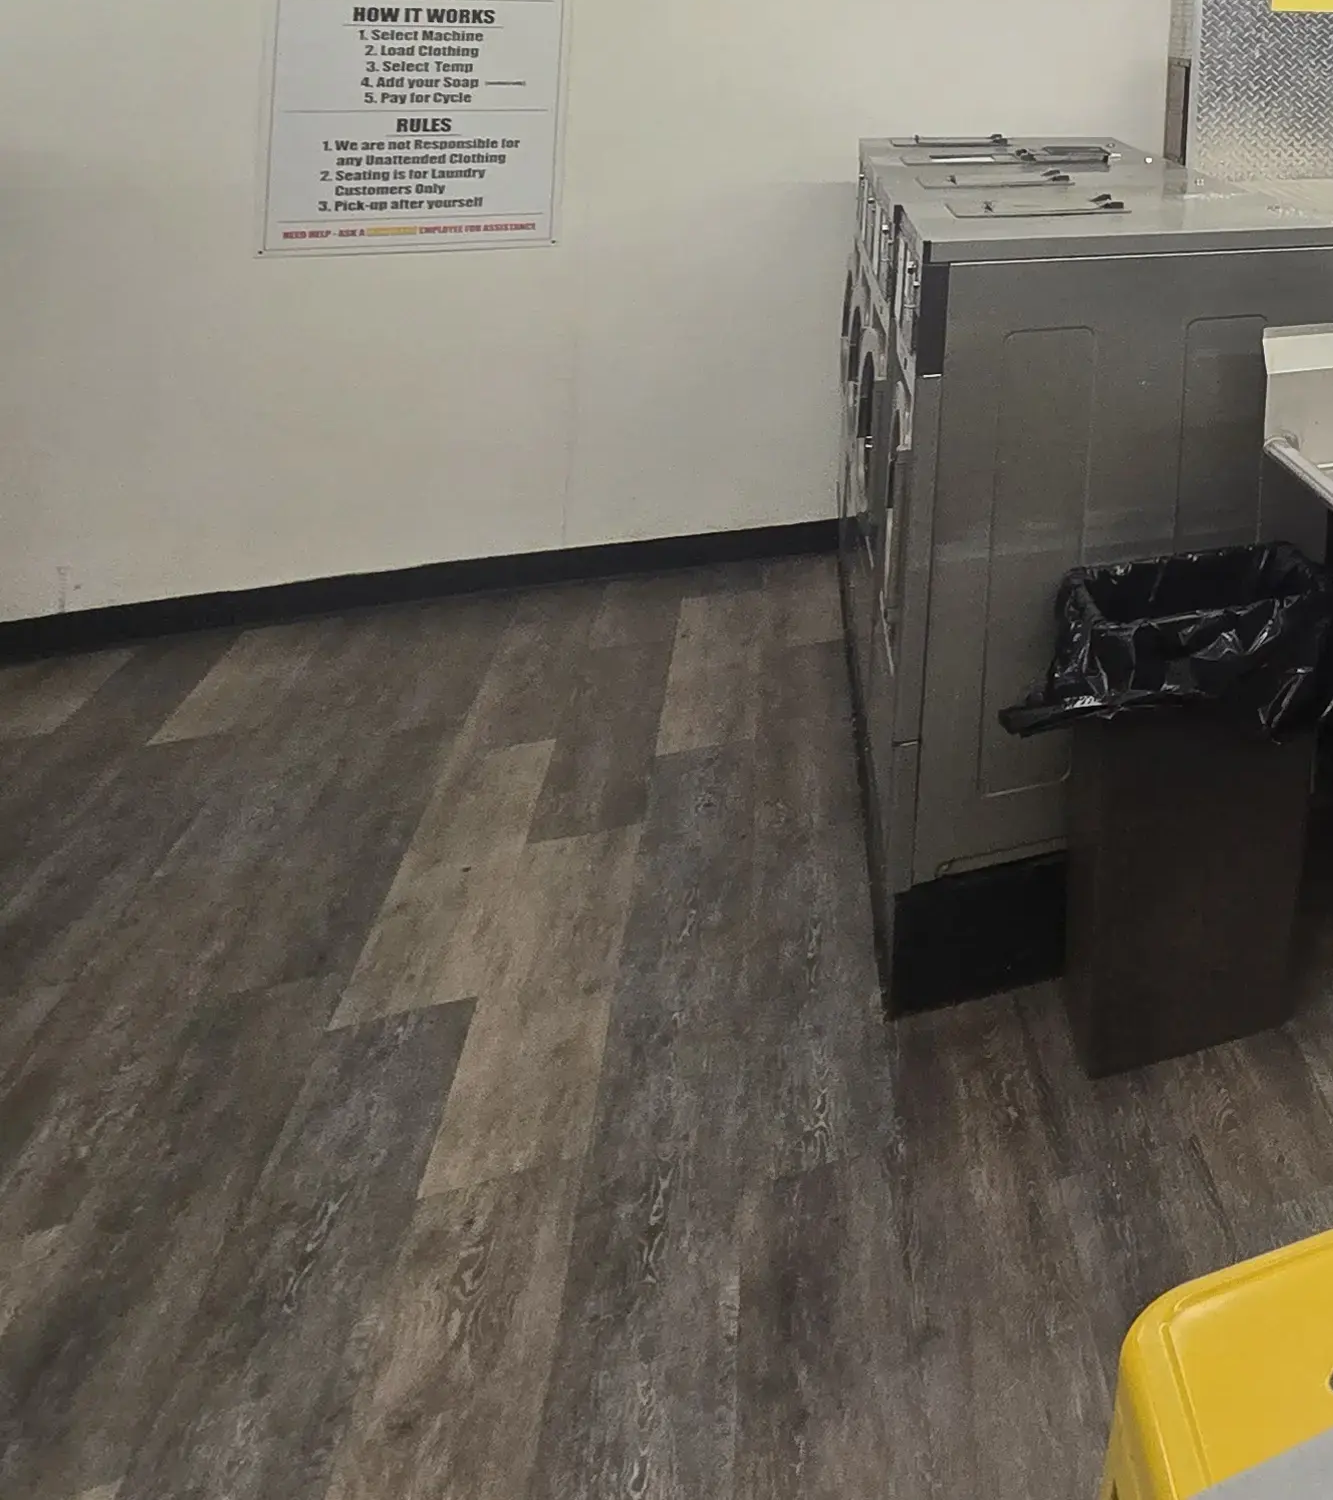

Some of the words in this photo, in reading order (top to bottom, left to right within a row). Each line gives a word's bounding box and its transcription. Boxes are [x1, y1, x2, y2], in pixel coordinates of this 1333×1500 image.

[353, 7, 400, 23] HOW
[404, 8, 423, 23] IT
[426, 8, 496, 24] WORKS
[358, 29, 369, 41] 1.
[371, 29, 419, 41] Select
[422, 29, 484, 42] Machine
[364, 45, 378, 57] 2.
[380, 45, 415, 57] Load
[418, 45, 480, 58] Clothing
[366, 61, 379, 73] 3.
[382, 61, 430, 73] Select
[433, 61, 474, 74] Temp
[361, 76, 373, 88] 4.
[376, 76, 404, 88] Add
[407, 78, 440, 89] your
[443, 76, 479, 89] Soap
[364, 92, 378, 104] 5.
[380, 92, 406, 105] Pay
[410, 92, 430, 104] for
[433, 92, 472, 105] Cycle
[396, 118, 452, 133] RULES
[322, 141, 332, 151] 1.
[334, 140, 358, 151] We
[361, 141, 385, 151] are
[388, 139, 411, 150] not
[414, 138, 498, 152] Responsible
[501, 138, 520, 149] for
[336, 156, 362, 168] any
[365, 153, 446, 166] Unattended
[449, 153, 506, 165] Clothing
[320, 171, 332, 181] 2.
[335, 170, 390, 182] Seating
[393, 169, 406, 180] is
[408, 169, 428, 180] for
[431, 167, 486, 180] Laundry
[334, 184, 412, 196] Customers
[415, 183, 446, 195] Only
[318, 201, 331, 212] 3.
[334, 200, 388, 212] Pick-up
[390, 198, 423, 210] after
[426, 197, 483, 210] yourself
[282, 231, 307, 240] NEED
[308, 230, 332, 239] HELP
[338, 229, 359, 237] ASK
